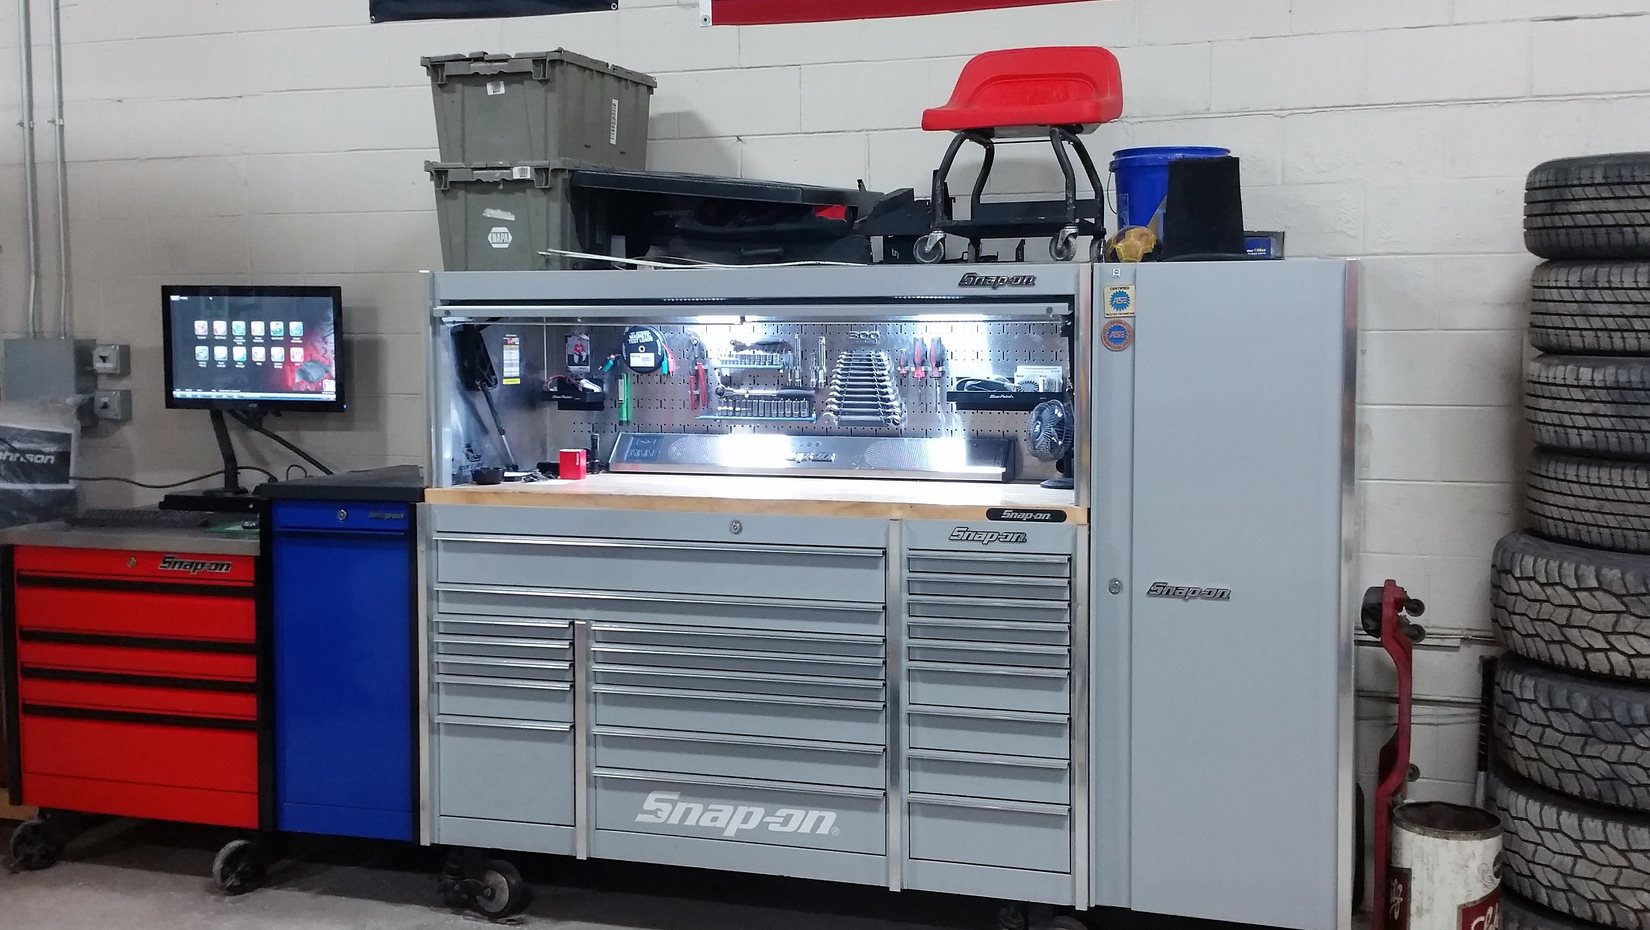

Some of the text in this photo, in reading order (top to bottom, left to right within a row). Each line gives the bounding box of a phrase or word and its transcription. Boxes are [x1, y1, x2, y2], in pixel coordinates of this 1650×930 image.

[491, 232, 510, 244] NAPA
[958, 271, 1037, 290] Snap-on
[1111, 296, 1129, 305] ASE
[1109, 330, 1126, 339] ASE
[0, 450, 55, 465] hnson
[1000, 509, 1052, 521] Snap-on
[949, 526, 1028, 545] Snap-on
[158, 555, 232, 574] Snap-on
[1146, 581, 1231, 602] Snap-on
